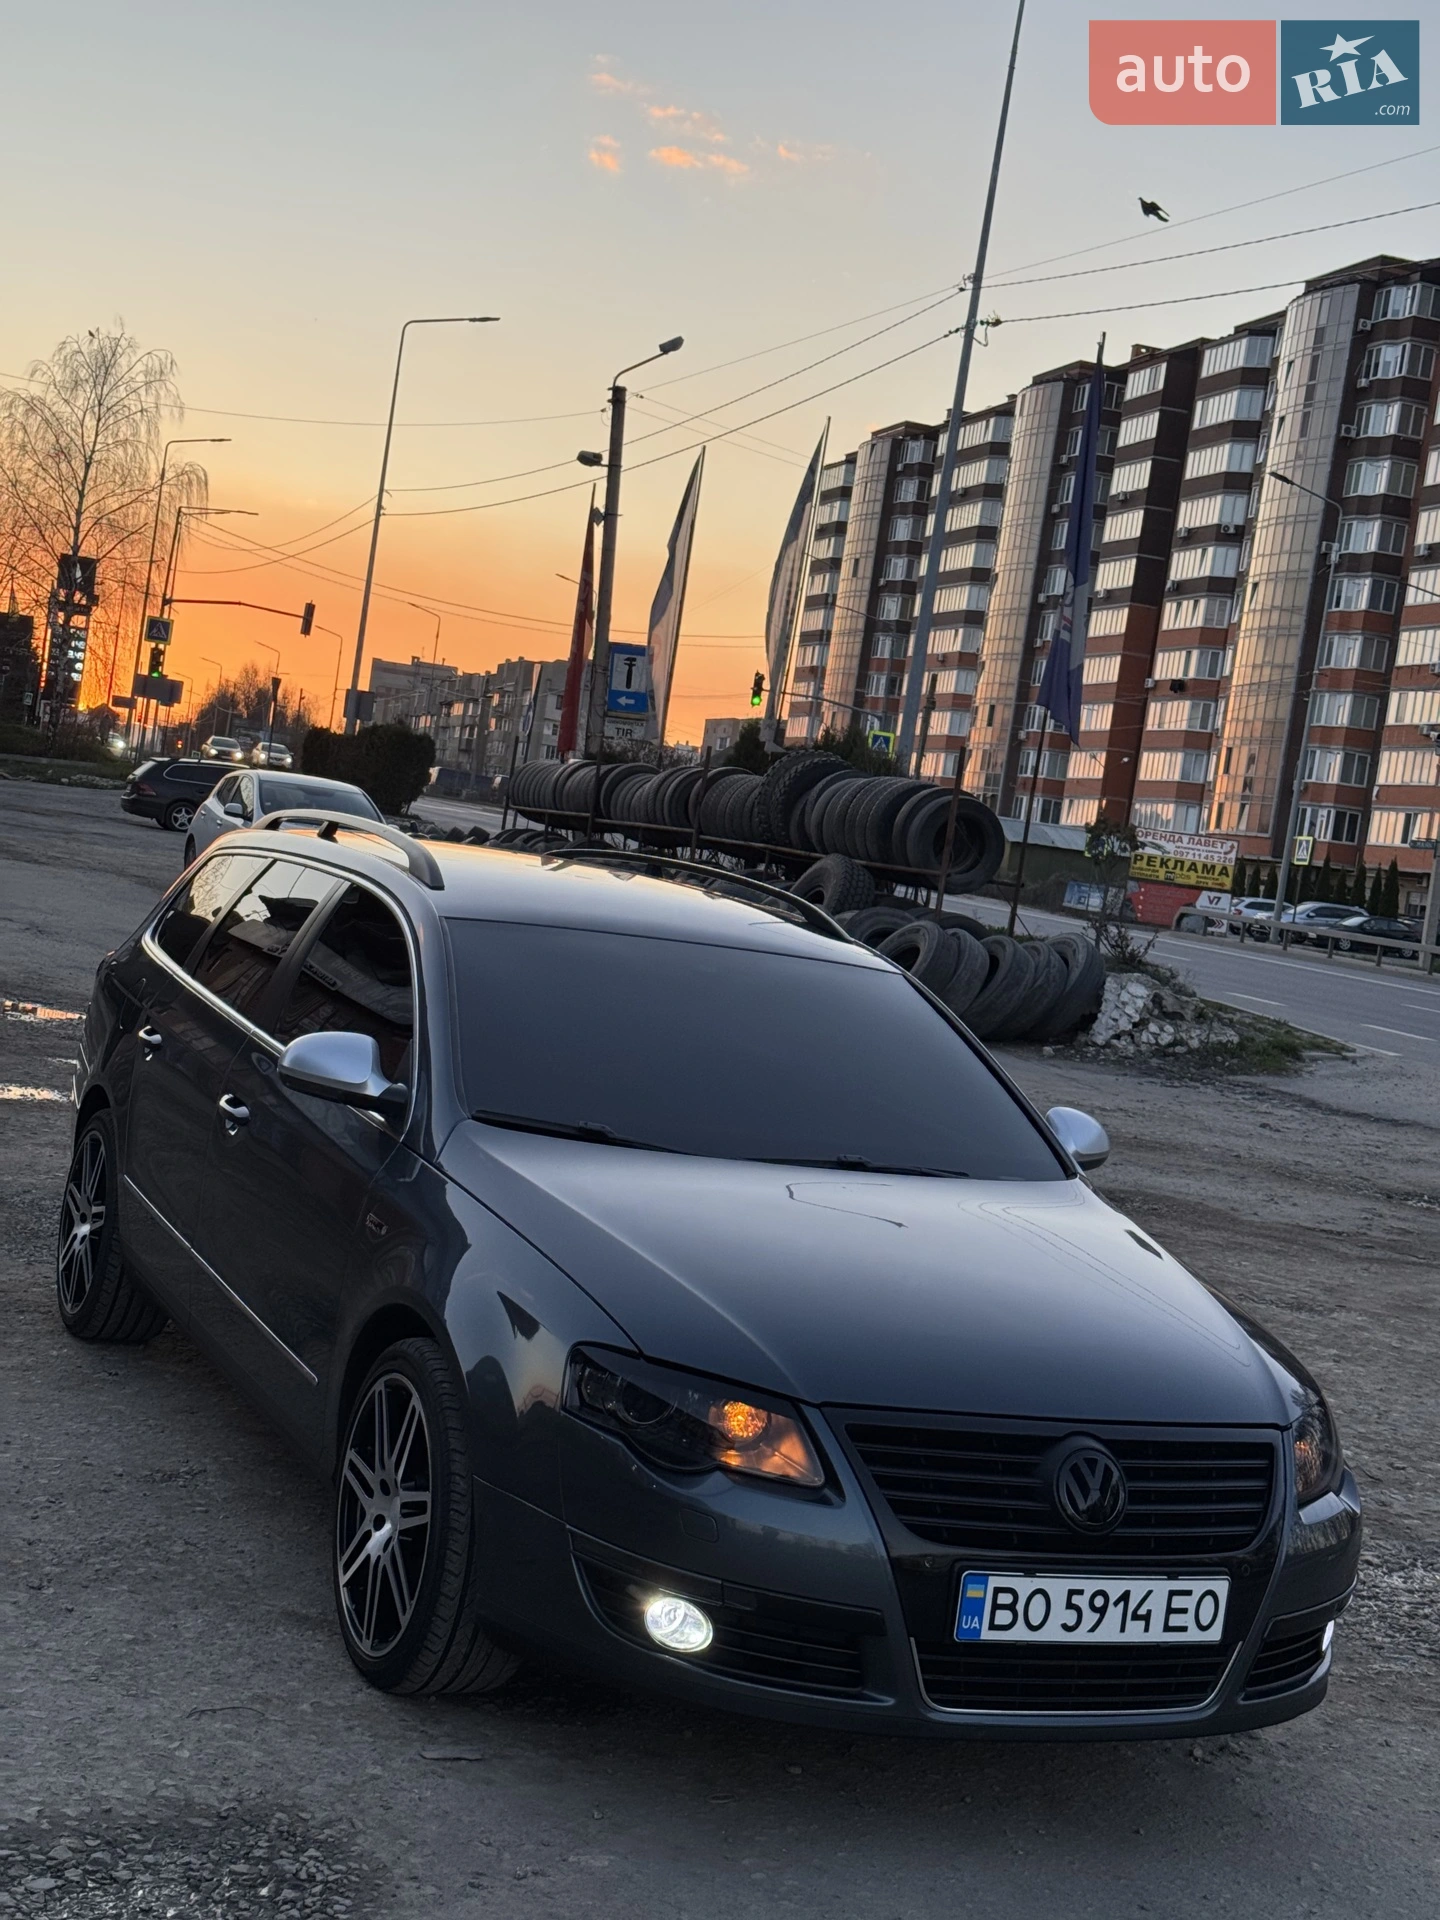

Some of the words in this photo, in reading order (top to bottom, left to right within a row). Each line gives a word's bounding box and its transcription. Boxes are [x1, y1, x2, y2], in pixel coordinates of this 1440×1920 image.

[615, 727, 633, 737] TIR
[1136, 830, 1183, 844] ОРЕНДА
[1187, 836, 1227, 850] ЛАВЕТ
[1133, 854, 1230, 878] РЕКЛАМА
[987, 1586, 1052, 1632] BO
[1060, 1588, 1153, 1633] 5914
[1162, 1589, 1220, 1633] EO
[962, 1616, 980, 1630] UA
